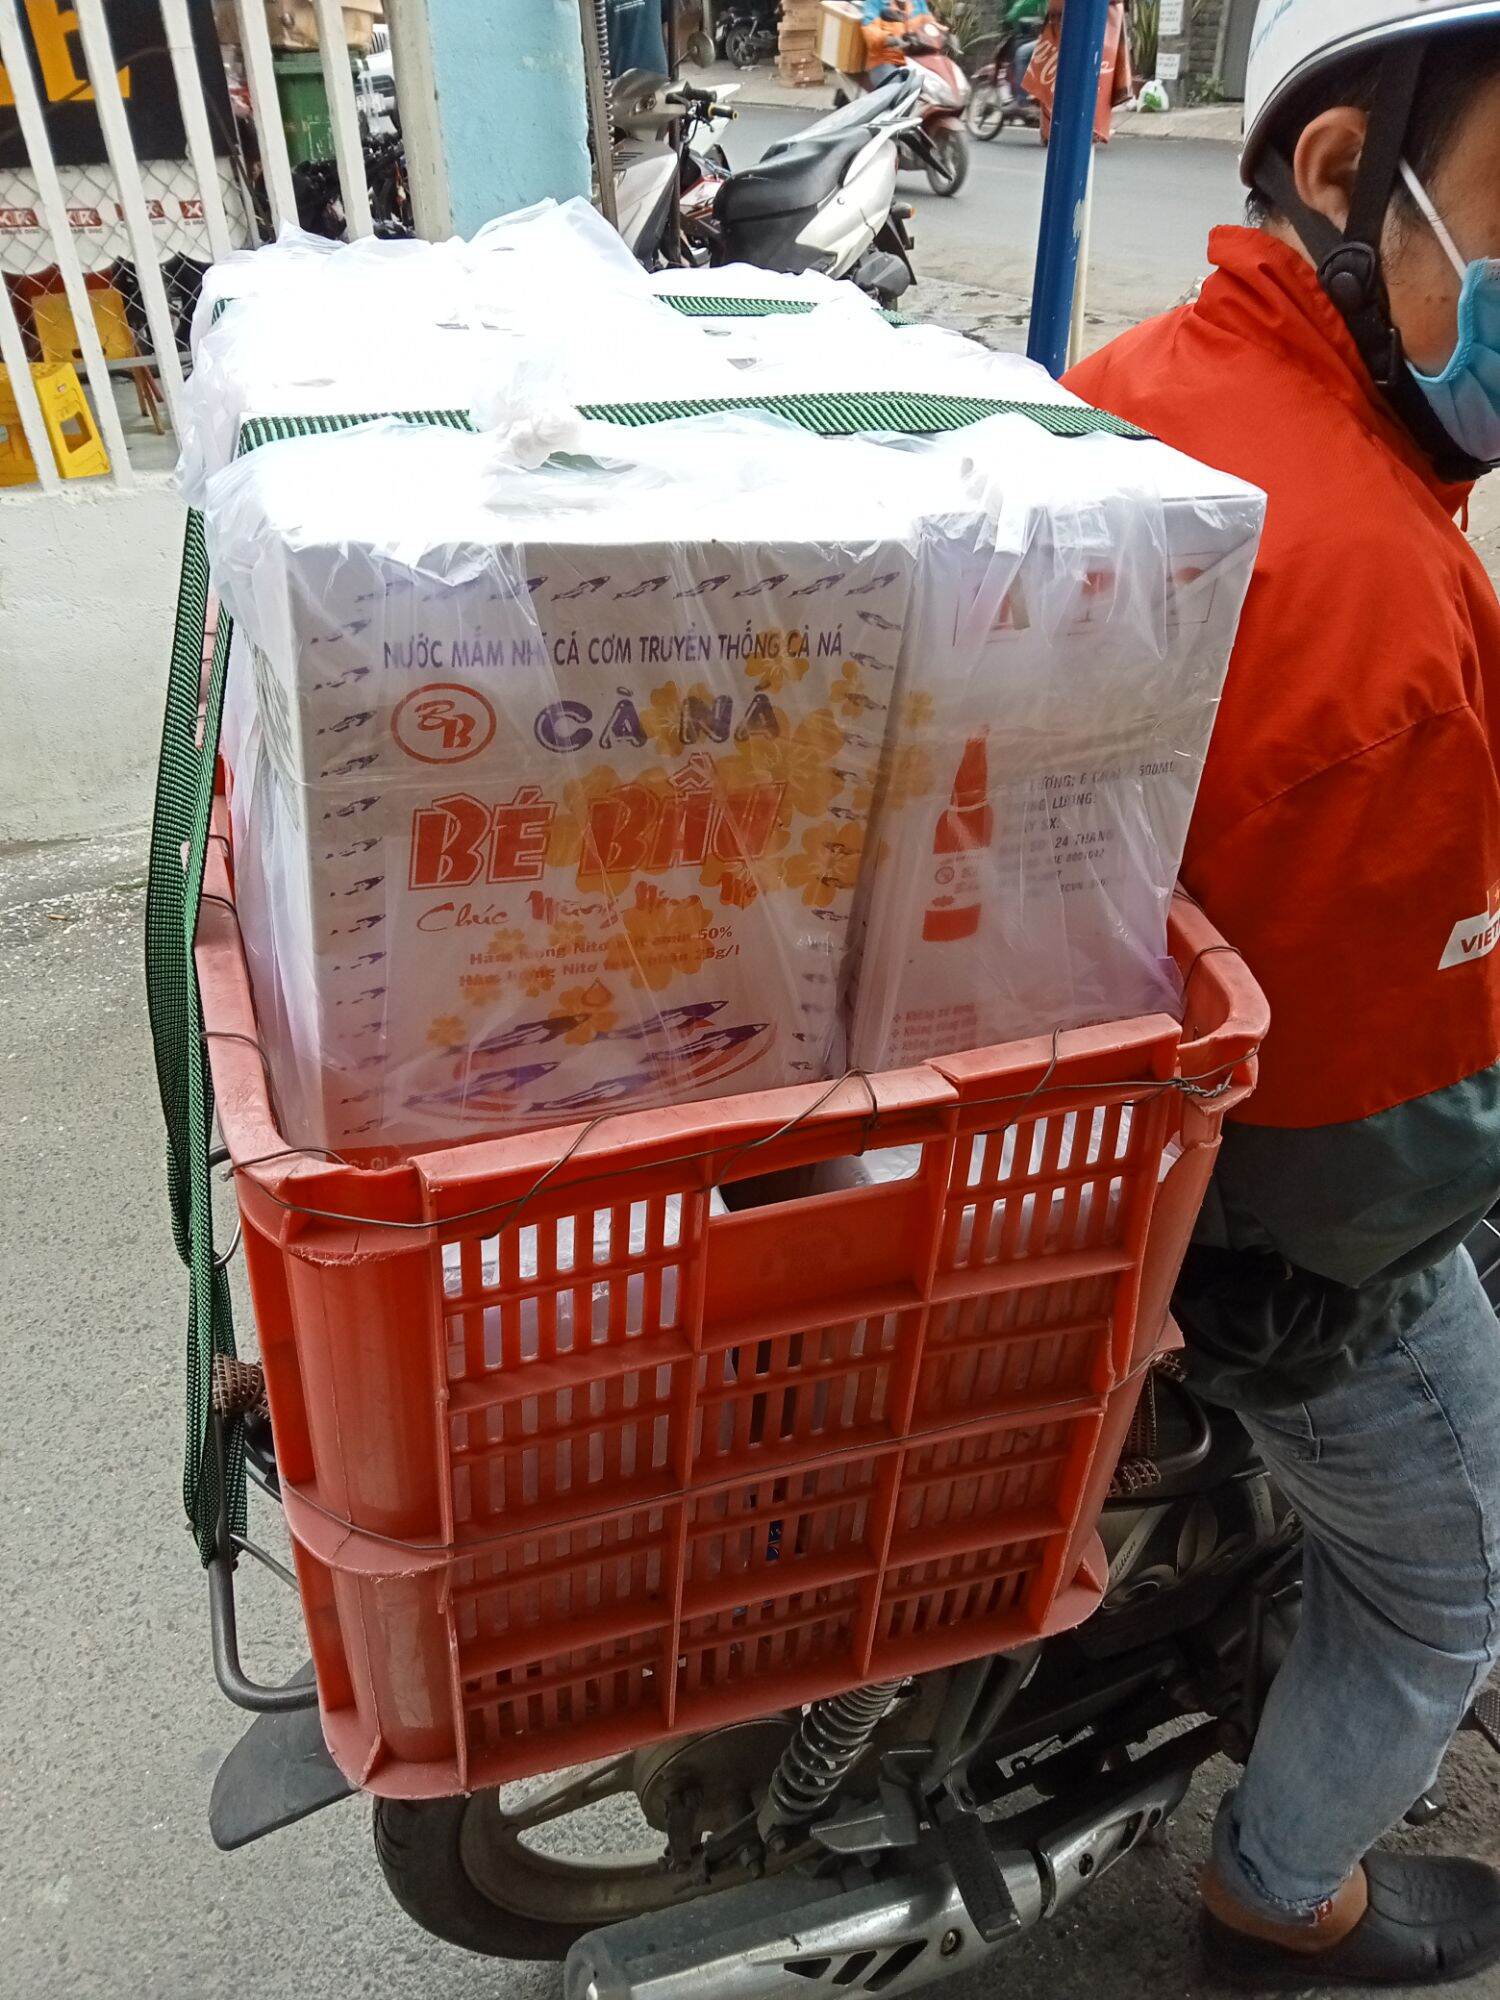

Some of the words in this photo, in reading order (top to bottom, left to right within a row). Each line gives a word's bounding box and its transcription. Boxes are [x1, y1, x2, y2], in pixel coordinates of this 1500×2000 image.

[384, 633, 443, 669] NƯỚC
[553, 630, 580, 666] CÁ
[588, 633, 632, 665] CƠM
[718, 619, 780, 661] THỐNG
[787, 624, 811, 657] CÀ
[817, 622, 843, 657] NÁ
[533, 686, 648, 754] CÀ
[678, 681, 781, 745] NÁ
[408, 785, 558, 891] BÉ
[1054, 836, 1069, 849] 24
[416, 902, 509, 931] Chúc
[699, 925, 733, 940] 50%
[1461, 918, 1500, 954] VIET
